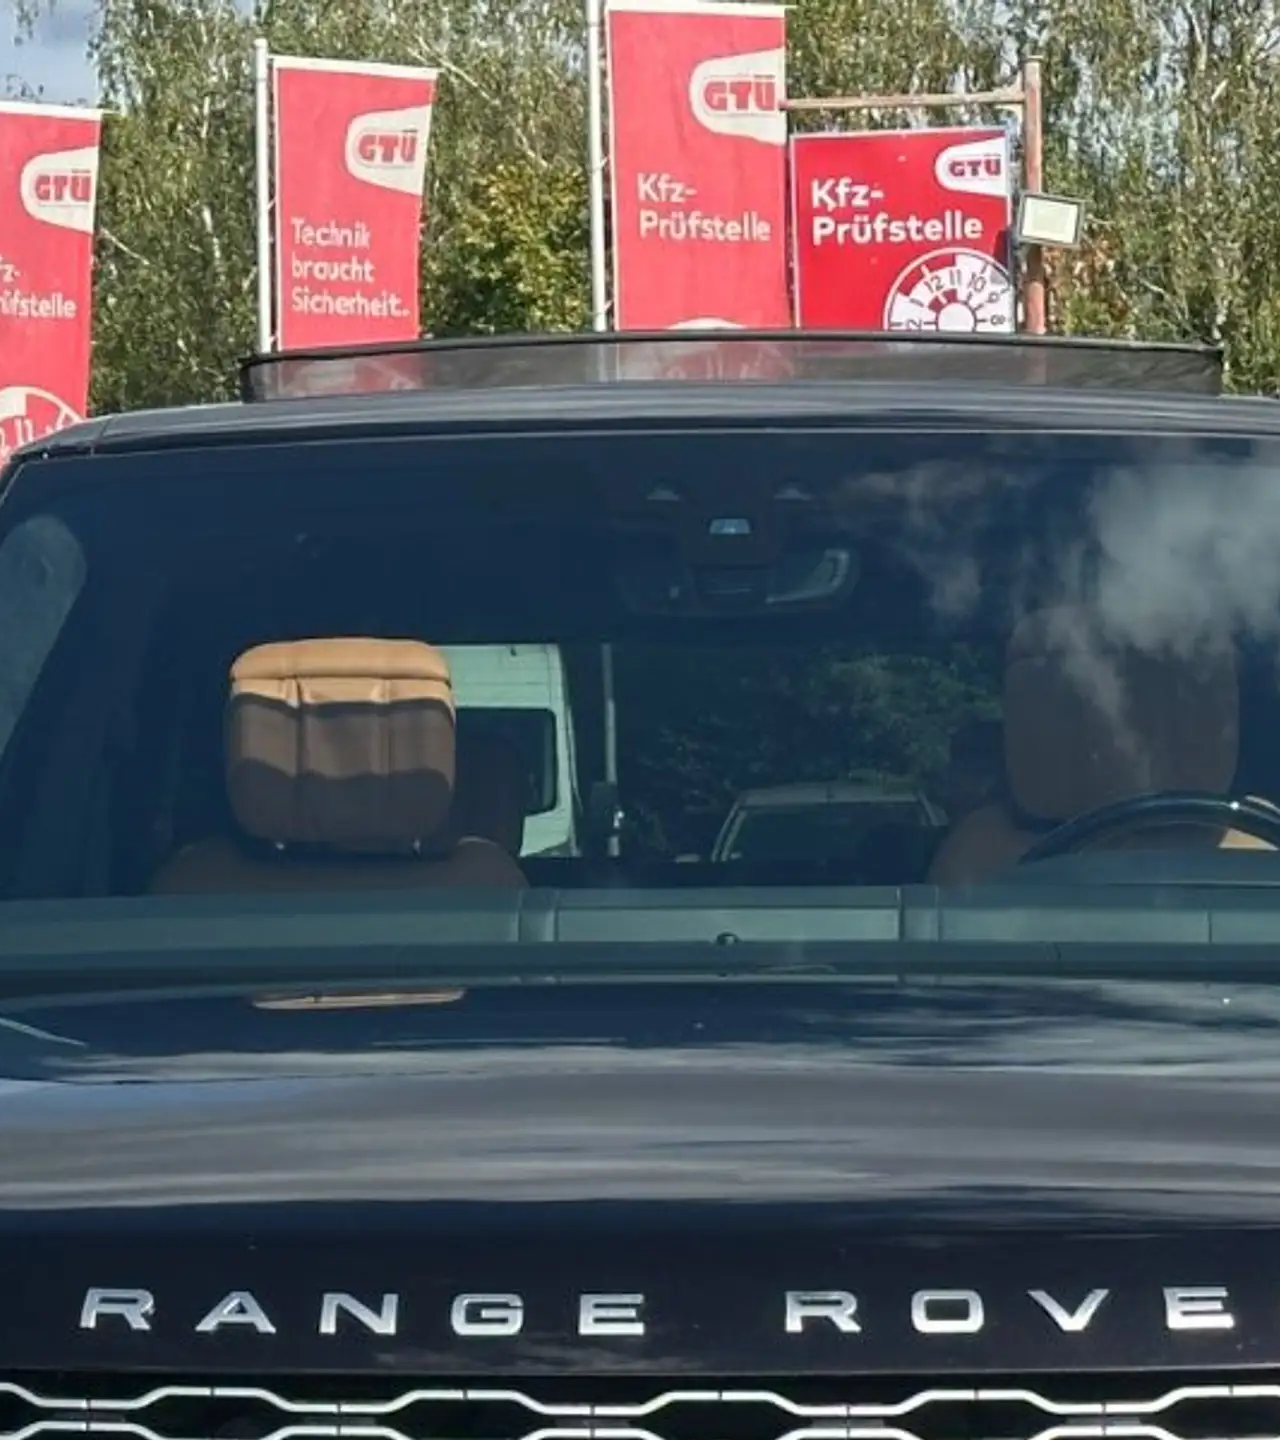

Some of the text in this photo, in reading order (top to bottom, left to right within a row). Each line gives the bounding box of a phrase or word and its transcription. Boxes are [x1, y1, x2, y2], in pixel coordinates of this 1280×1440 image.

[704, 73, 776, 111] GTÜ
[359, 129, 418, 162] GTÜ
[948, 153, 1001, 177] GTÜ
[35, 168, 92, 202] GTÜ
[637, 173, 697, 203] Kfz-
[811, 180, 885, 209] Kfz-
[291, 216, 371, 248] Technik
[639, 209, 771, 242] Prüfstelle
[812, 209, 983, 247] Prüfstelle
[290, 251, 376, 284] braucht
[291, 285, 411, 319] Sicherheit.
[78, 1287, 646, 1336] RANGE
